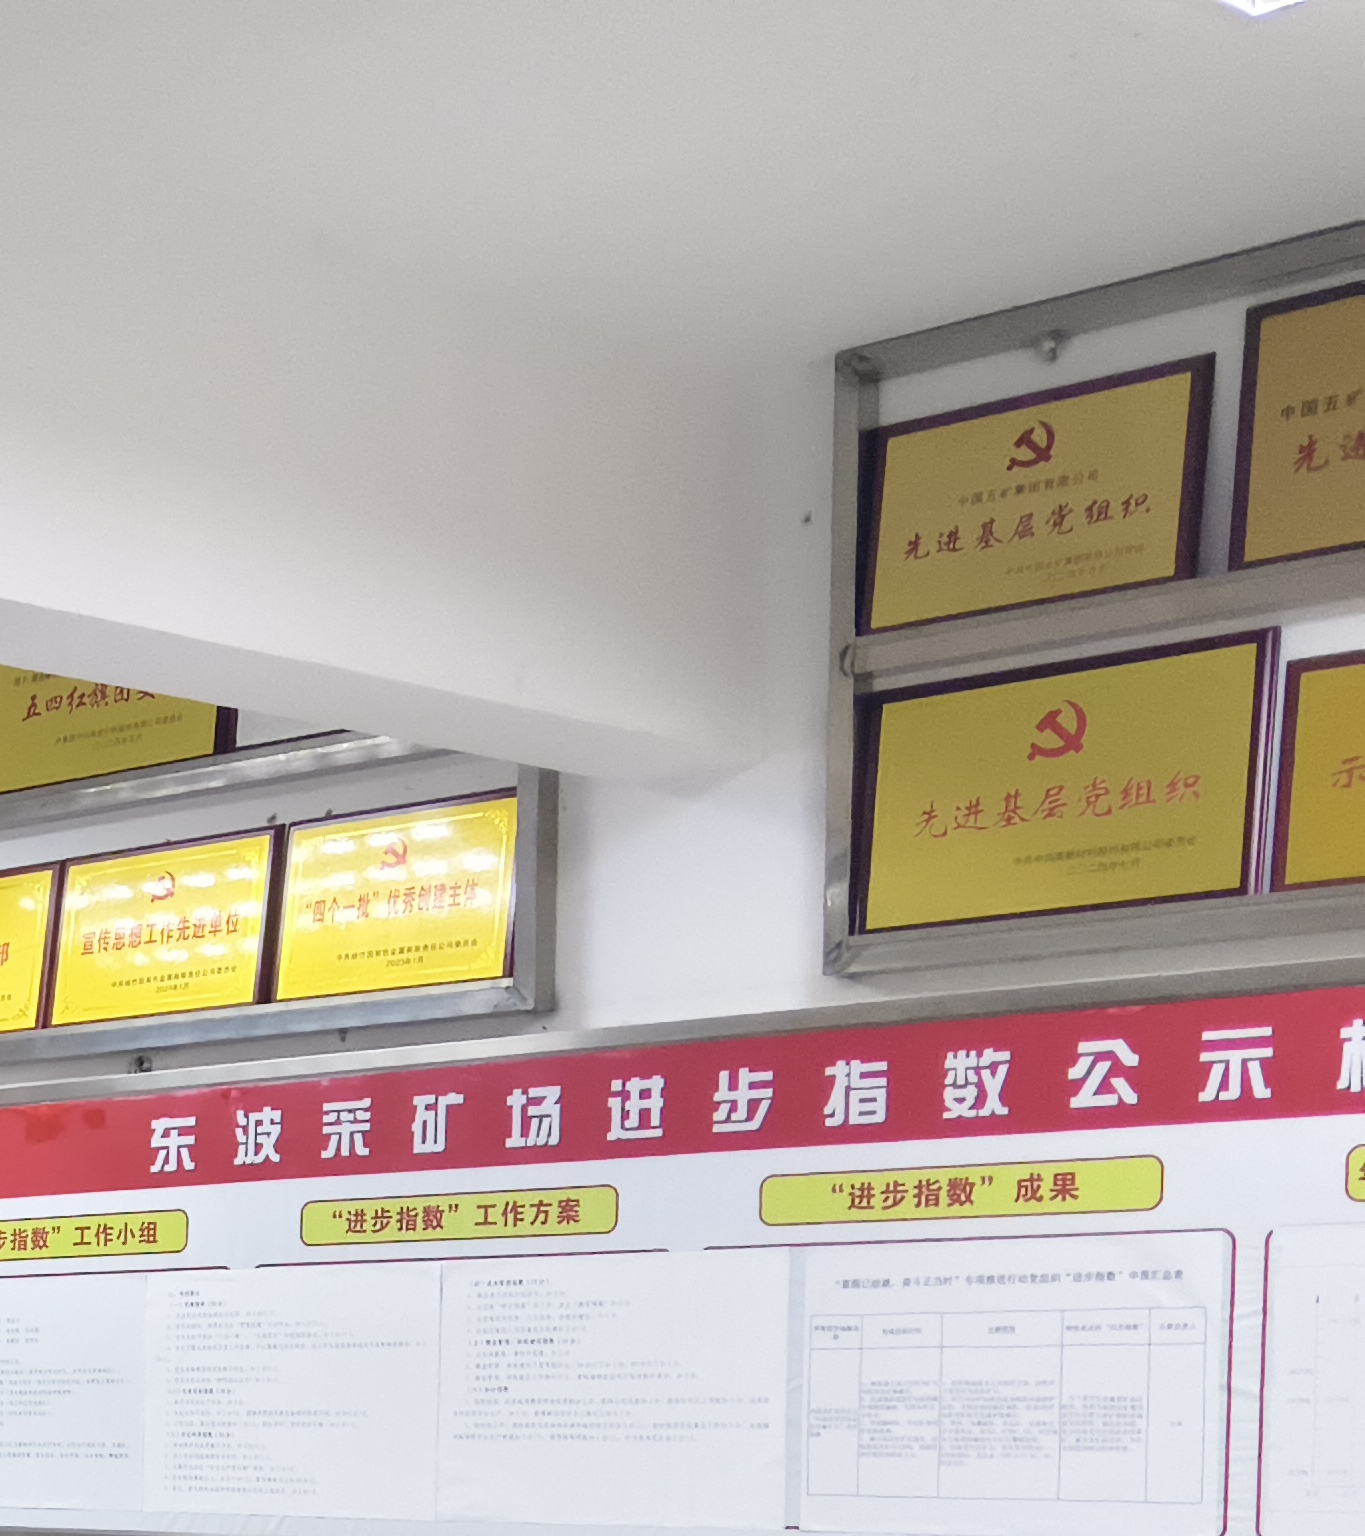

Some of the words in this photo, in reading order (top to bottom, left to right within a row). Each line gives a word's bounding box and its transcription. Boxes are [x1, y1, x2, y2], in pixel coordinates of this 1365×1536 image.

[903, 493, 1151, 561] 先进基层党组织
[913, 770, 1201, 838] 先进基层党组织
[81, 911, 241, 955] 宣传思想工作先进单位
